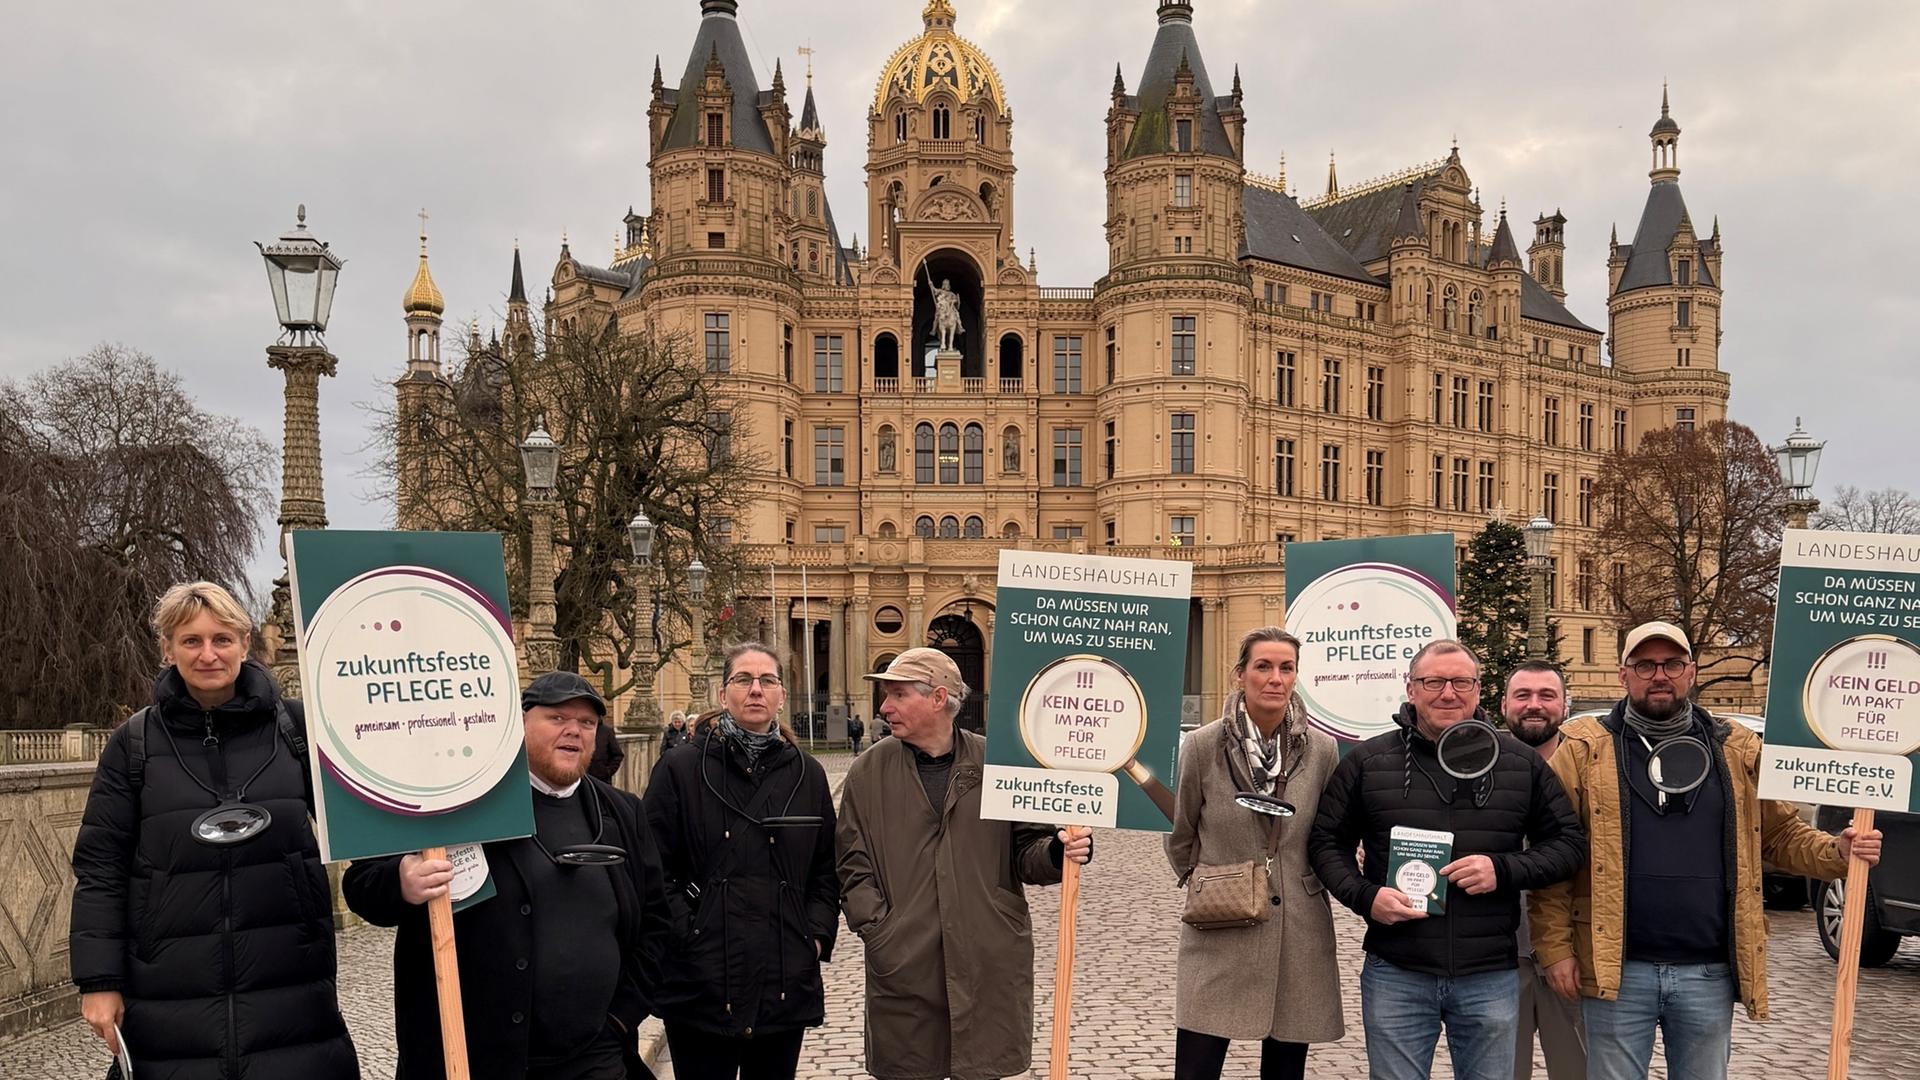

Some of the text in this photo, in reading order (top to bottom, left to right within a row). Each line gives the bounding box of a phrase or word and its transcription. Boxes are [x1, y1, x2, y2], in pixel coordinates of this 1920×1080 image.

[1011, 563, 1179, 588] LANDESHAUSHALT
[1824, 576, 1915, 593] DA MÜSSEN
[1036, 597, 1149, 616] DA MÜSSEN WIR
[1795, 592, 1849, 606] SCHON
[1853, 595, 1896, 610] GANZ
[1010, 612, 1172, 636] SCHON GANZ NAH RAN,
[1809, 610, 1836, 623] UM
[1840, 612, 1875, 626] WAS
[1879, 614, 1899, 627] ZU
[1024, 630, 1157, 651] UM WAS ZU SEHEN.
[1305, 623, 1432, 643] zukunftsfeste
[1326, 644, 1397, 662] PFLEGE
[1867, 652, 1887, 669] !!!
[336, 651, 490, 677] zukunftsfeste
[1076, 671, 1094, 689] !!!
[1313, 673, 1350, 687] gemeinsam
[1355, 668, 1397, 685] professionell
[1828, 675, 1920, 695] KEIN GELD
[366, 676, 495, 704] PFLEGE e.V.
[1042, 695, 1125, 713] KEIN GELD
[1842, 694, 1904, 710] IM PAKT
[355, 709, 497, 740] gemeinsam professionell gestalten
[1055, 713, 1110, 729] IM PAKT
[1857, 710, 1886, 725] FÜR
[1068, 729, 1094, 743] FÜR
[1840, 726, 1899, 743] PFLEGE!
[1054, 745, 1106, 760] PFLEGE!
[1775, 758, 1895, 780] zukunftsfeste
[995, 777, 1104, 797] zukunftsfeste
[1793, 775, 1893, 798] PFLEGE e.V.
[1012, 795, 1103, 815] PFLEGE e.V.
